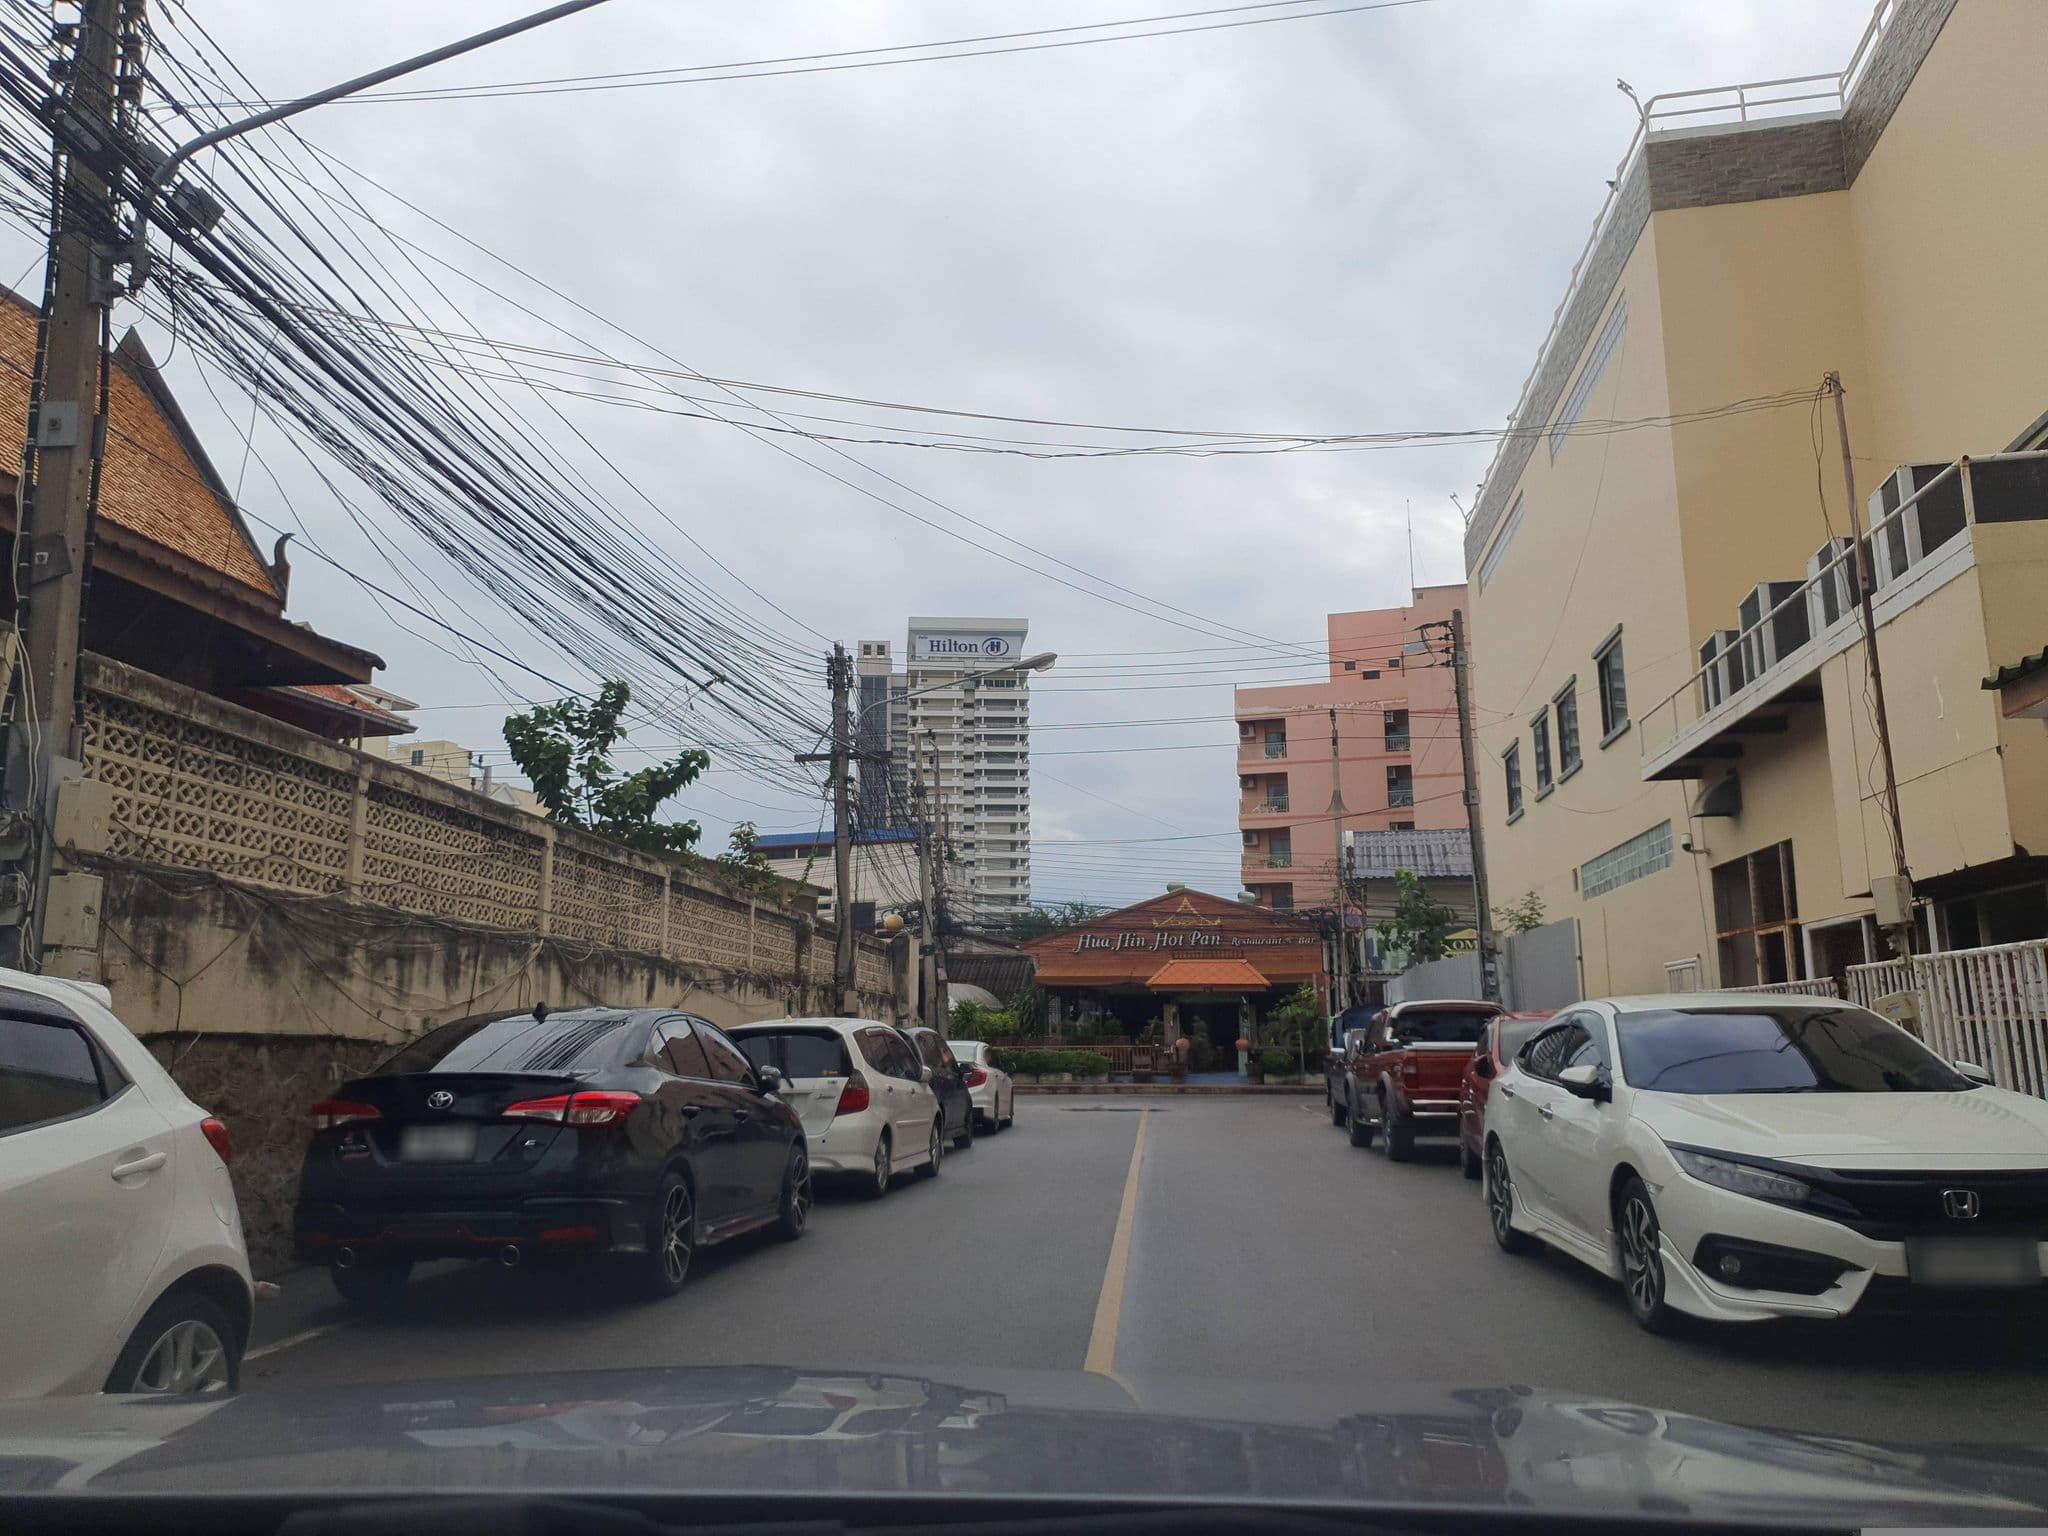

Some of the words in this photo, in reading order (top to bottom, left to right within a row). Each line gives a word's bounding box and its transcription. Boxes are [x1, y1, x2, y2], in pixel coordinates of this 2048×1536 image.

[929, 639, 979, 653] Hilton
[1072, 934, 1111, 953] Hua
[1111, 932, 1146, 951] Hin
[1149, 932, 1184, 951] Hot
[1188, 930, 1221, 946] Pan
[1231, 936, 1283, 946] Restaurant
